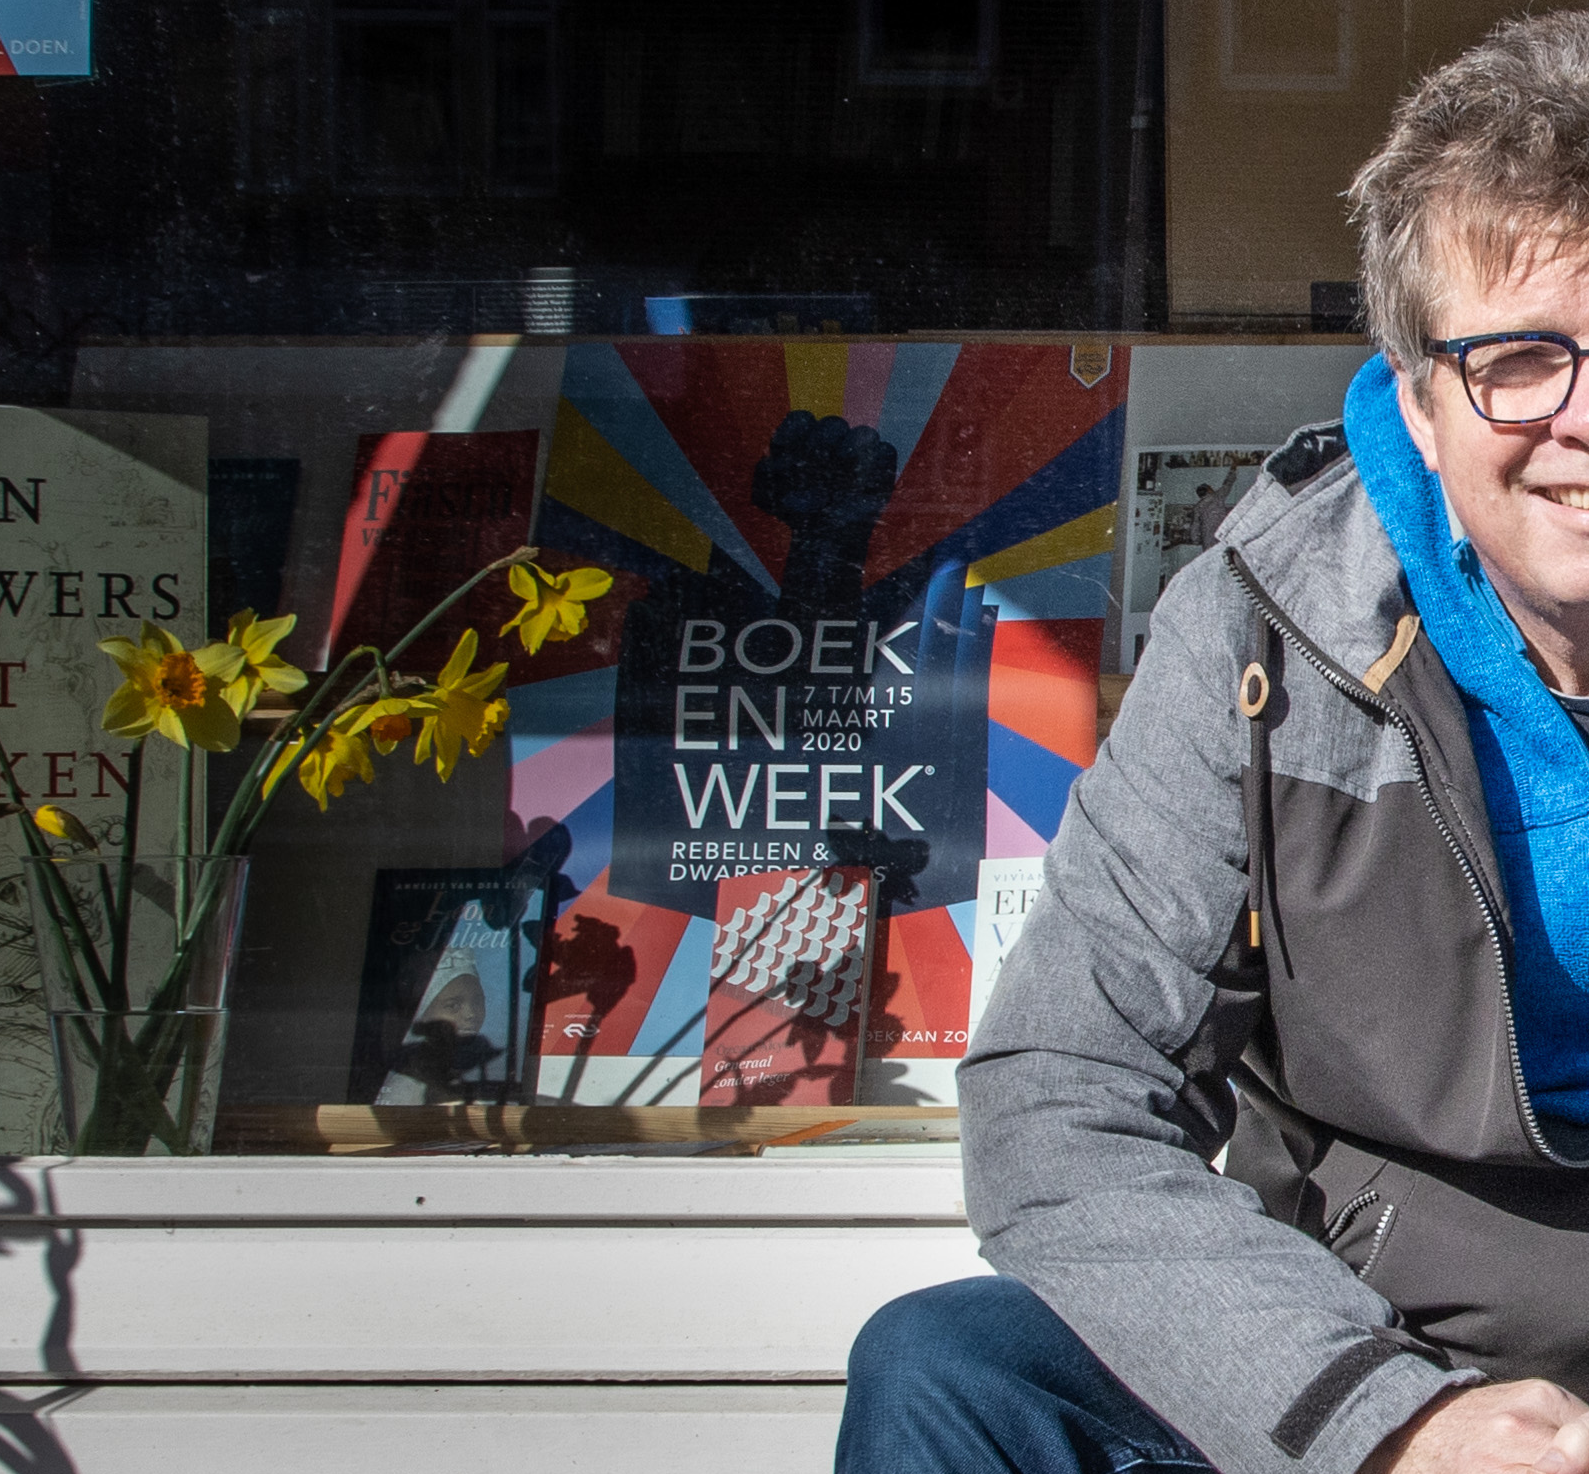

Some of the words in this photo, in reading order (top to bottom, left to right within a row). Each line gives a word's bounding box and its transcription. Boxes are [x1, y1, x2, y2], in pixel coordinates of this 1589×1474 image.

[10, 38, 75, 56] DOEN.
[677, 618, 920, 675] BOEK
[674, 684, 787, 751] EN
[803, 685, 817, 705] 7
[826, 685, 877, 706] T/M
[885, 685, 914, 706] 15
[802, 708, 896, 729] MAART
[801, 732, 863, 752] 2020
[671, 841, 802, 861] REBELLEN
[811, 841, 831, 862] &
[900, 1029, 938, 1044] KAN
[714, 1054, 775, 1073] Generaal
[713, 1074, 758, 1089] zonder
[757, 1071, 791, 1087] leger
